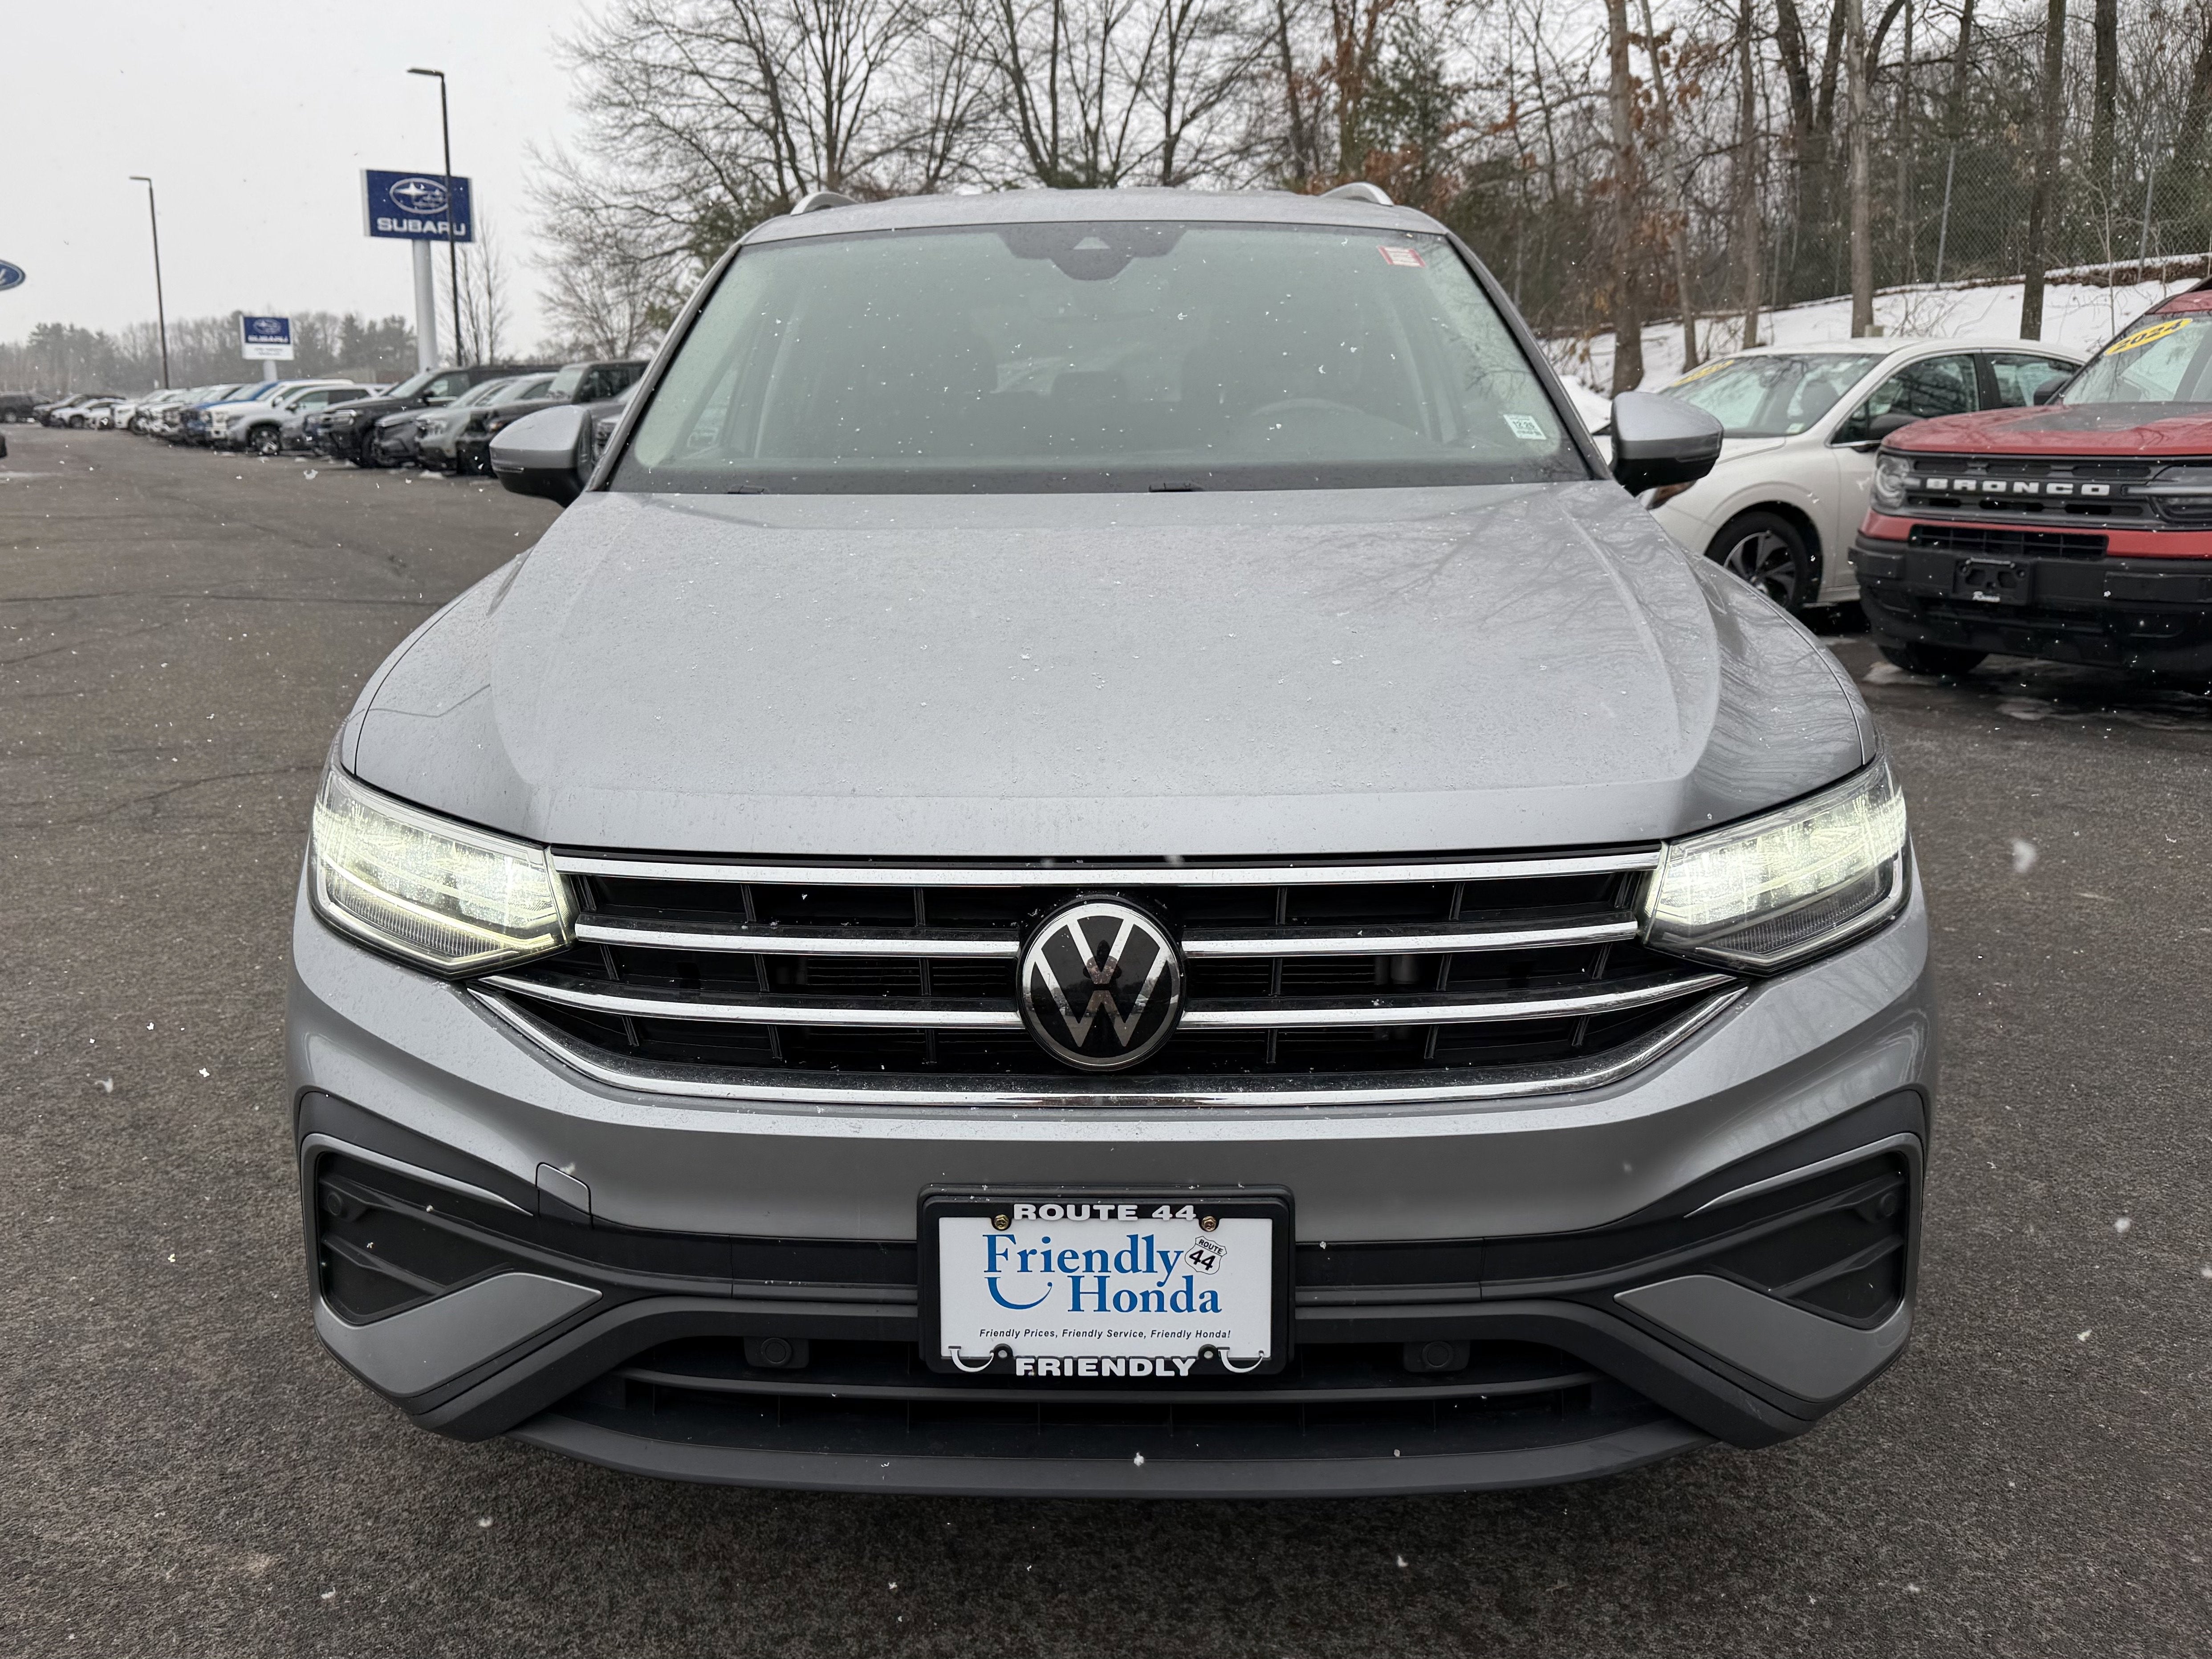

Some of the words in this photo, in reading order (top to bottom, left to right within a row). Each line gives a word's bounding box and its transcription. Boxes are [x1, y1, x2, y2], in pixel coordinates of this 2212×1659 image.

[377, 217, 466, 236] SUBARU
[2114, 320, 2183, 351] 2024
[1926, 478, 2110, 496] BRONCO
[1014, 1204, 1138, 1221] ROUTE
[1152, 1205, 1197, 1221] 44
[1199, 1239, 1224, 1254] ROUTE
[982, 1234, 1184, 1287] Friendly
[1189, 1250, 1216, 1271] 44
[1068, 1275, 1222, 1313] Honda
[980, 1329, 1021, 1339] Friendly
[1024, 1329, 1058, 1338] Prices,
[1062, 1329, 1103, 1339] Friendly
[1106, 1330, 1147, 1339] Service,
[1151, 1330, 1191, 1339] Friendly
[1195, 1330, 1231, 1338] Honda!
[1016, 1358, 1196, 1376] FRIENDLY
